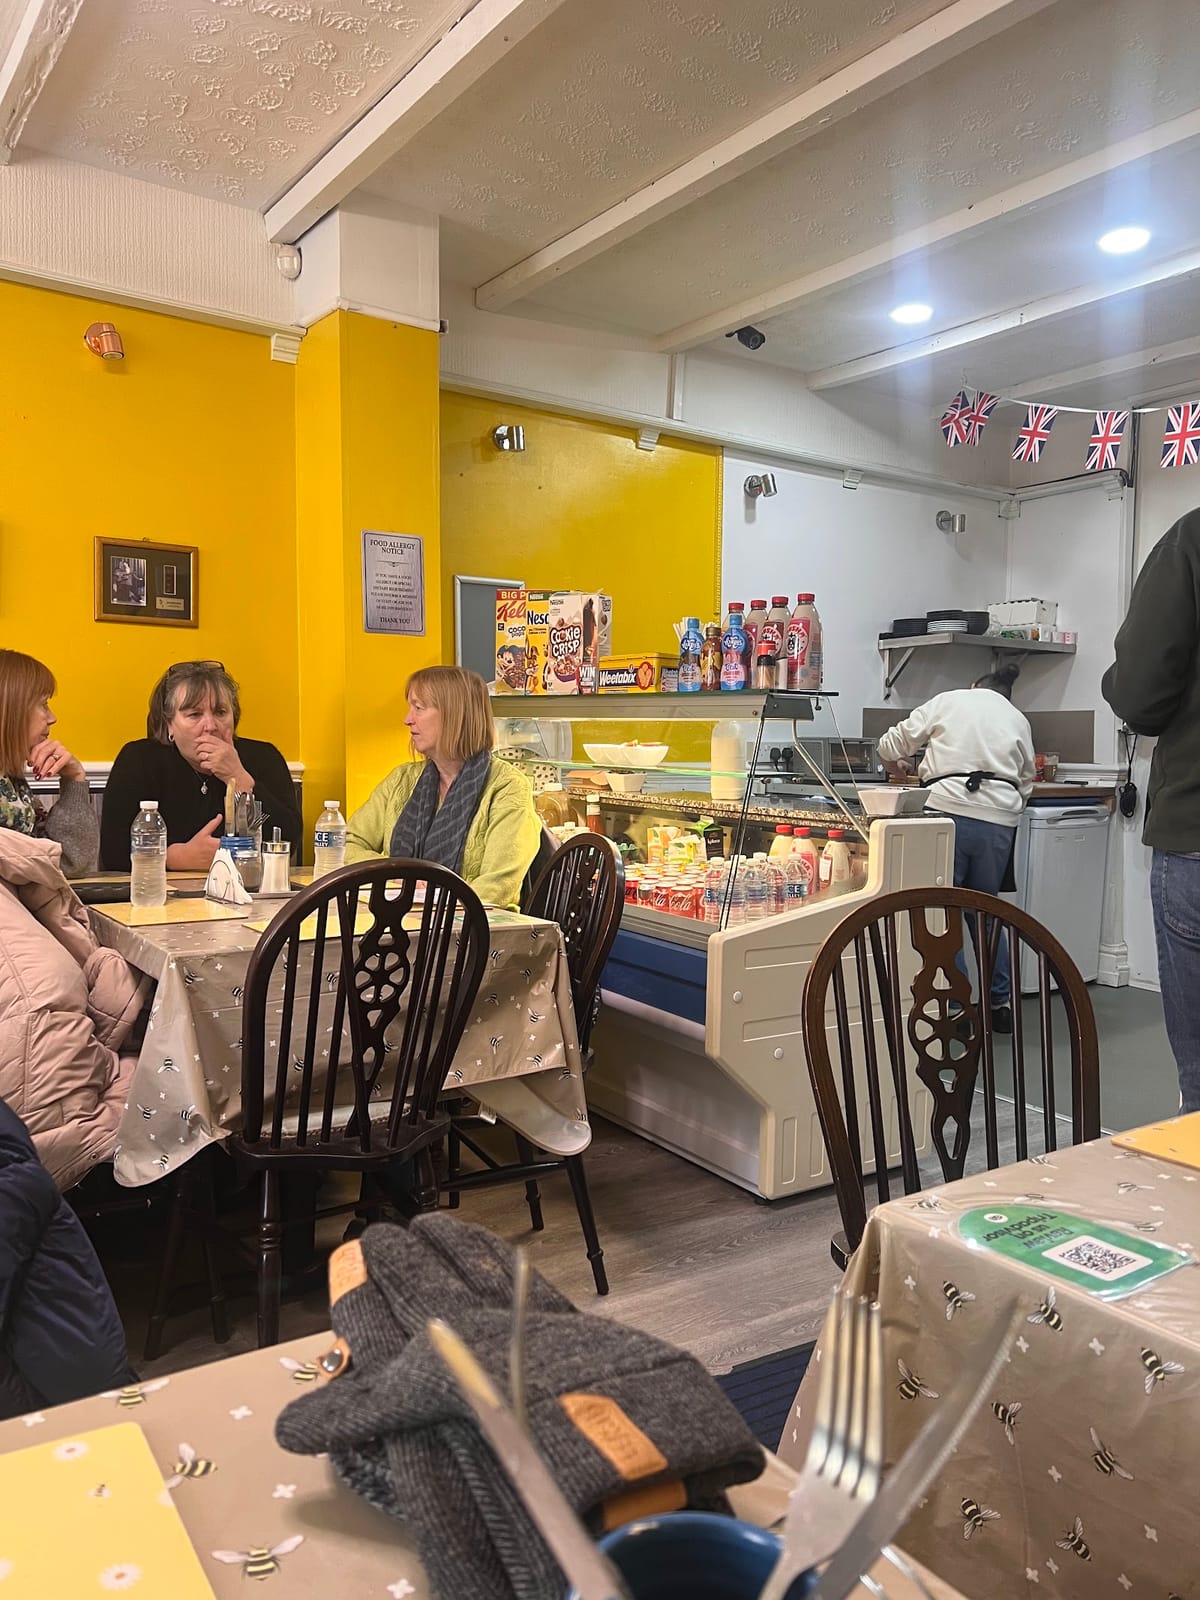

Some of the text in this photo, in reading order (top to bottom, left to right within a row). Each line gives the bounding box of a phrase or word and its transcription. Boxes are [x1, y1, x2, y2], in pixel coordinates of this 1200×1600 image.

[370, 539, 416, 550] FOOD ALLERGY
[381, 547, 404, 555] NOTICE
[501, 591, 518, 600] BIG
[579, 666, 596, 678] WIN
[599, 670, 637, 687] Weetabix
[787, 884, 801, 894] CE
[983, 1212, 1059, 1242] Tripadvisor
